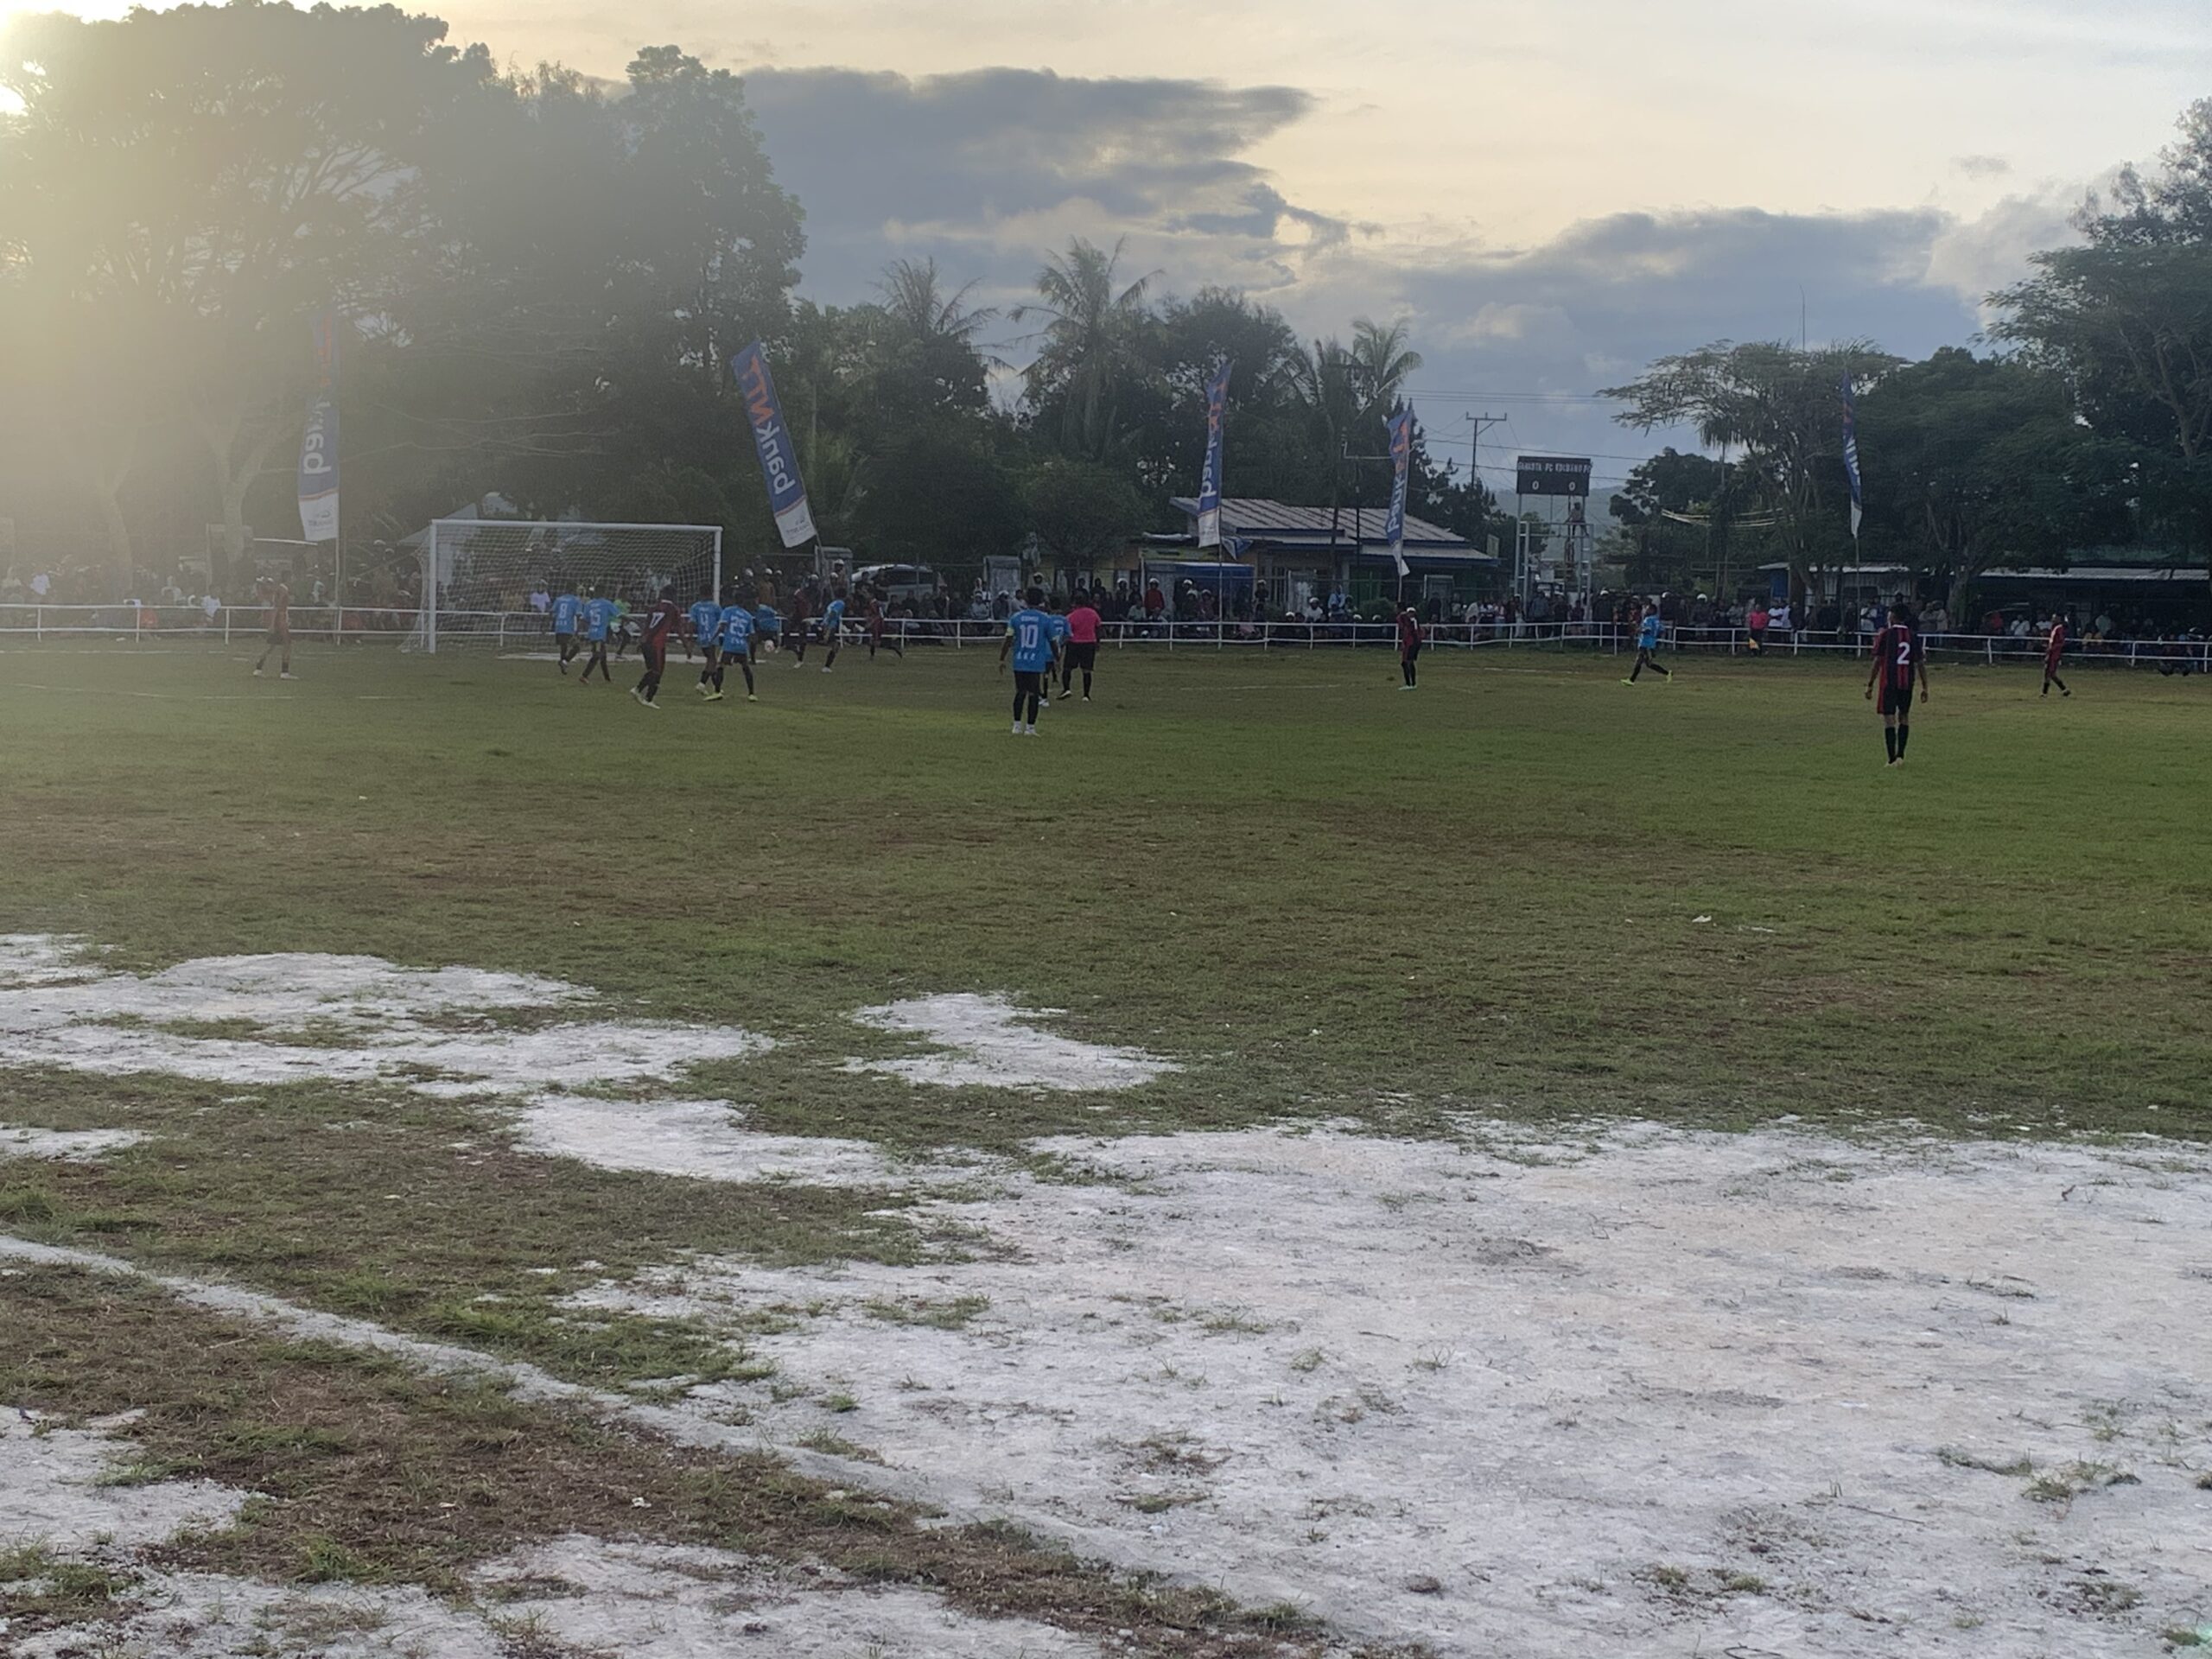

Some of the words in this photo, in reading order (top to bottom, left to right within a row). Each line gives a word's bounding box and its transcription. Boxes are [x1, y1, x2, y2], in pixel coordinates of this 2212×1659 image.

[1532, 480, 1539, 491] 0
[1568, 481, 1576, 492] 0
[559, 603, 568, 619] 8
[729, 614, 748, 638] 25
[1020, 624, 1039, 649] 10
[1897, 641, 1910, 664] 2
